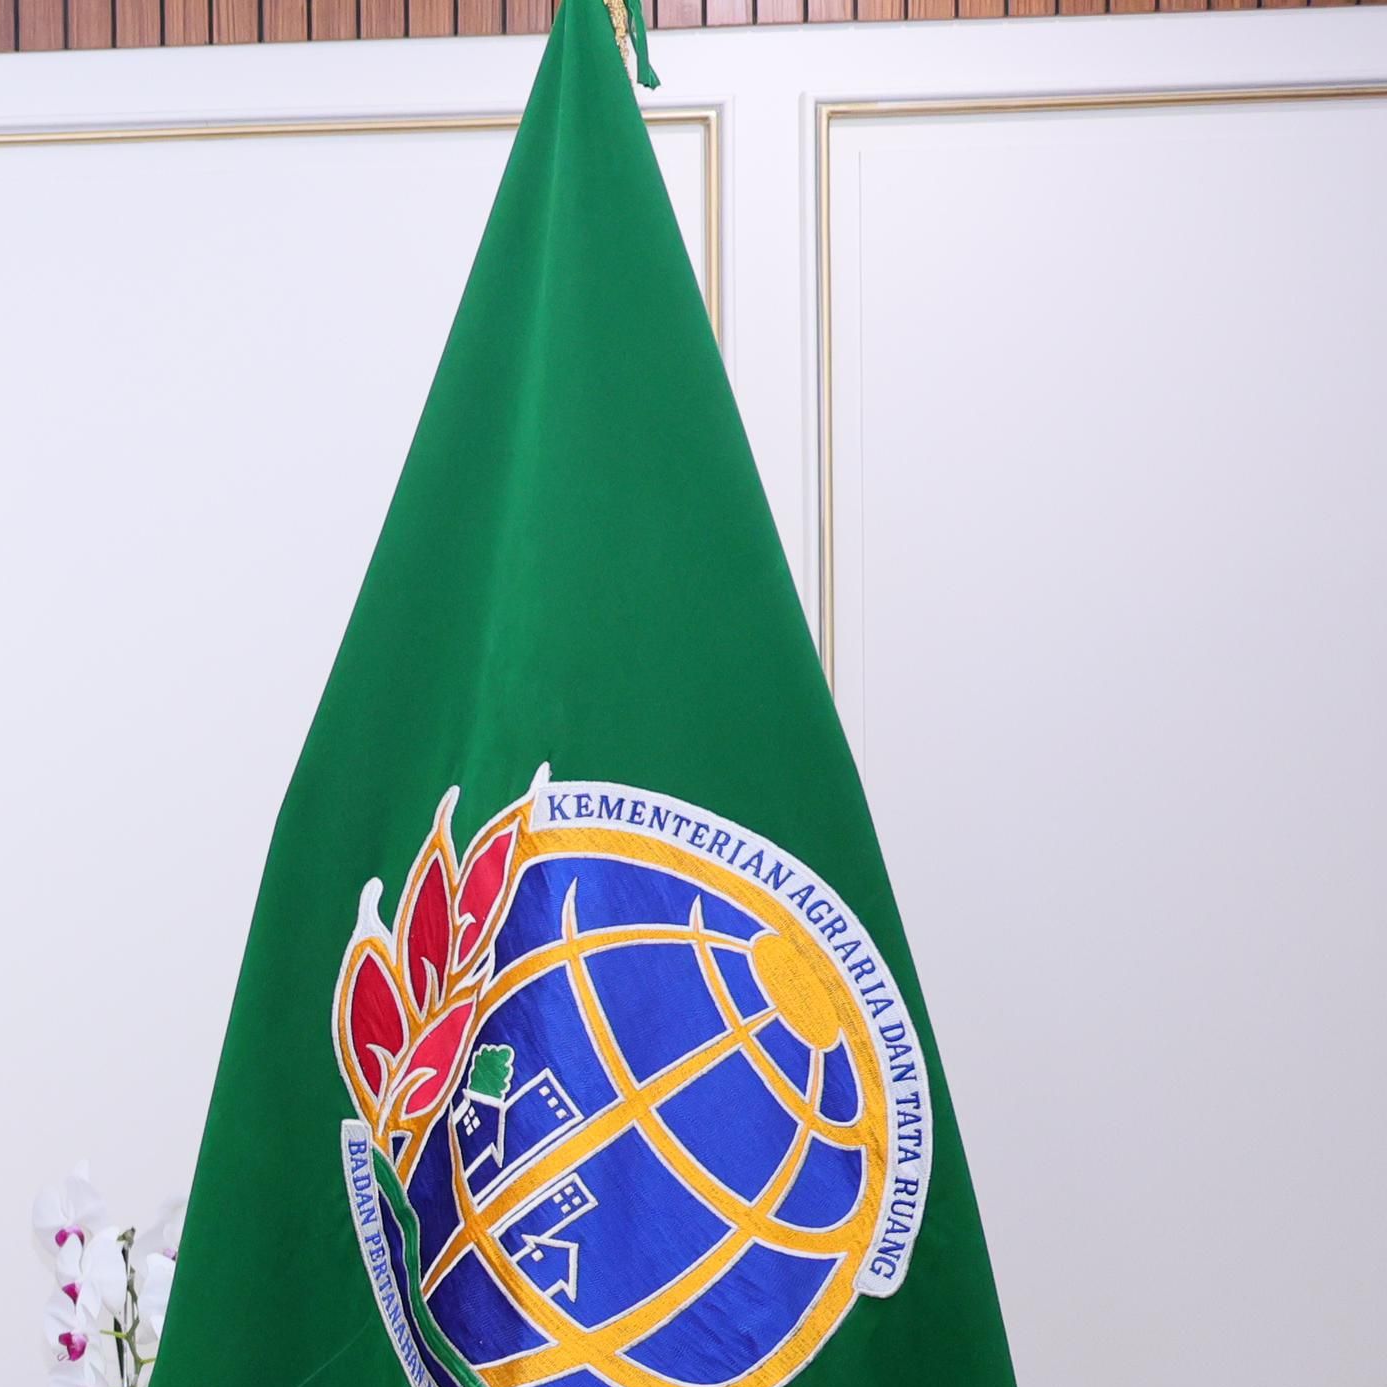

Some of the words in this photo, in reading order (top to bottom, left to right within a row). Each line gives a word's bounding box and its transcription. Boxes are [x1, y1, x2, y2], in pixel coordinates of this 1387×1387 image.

[547, 793, 796, 891] KEMENTERIAN
[788, 883, 895, 1018] AGRARIA
[878, 1020, 917, 1083] DAN
[895, 1090, 922, 1165] TATA
[348, 1138, 378, 1227] BADAN
[364, 1233, 426, 1386] PERTANAHAN
[869, 1178, 919, 1280] RUANG
